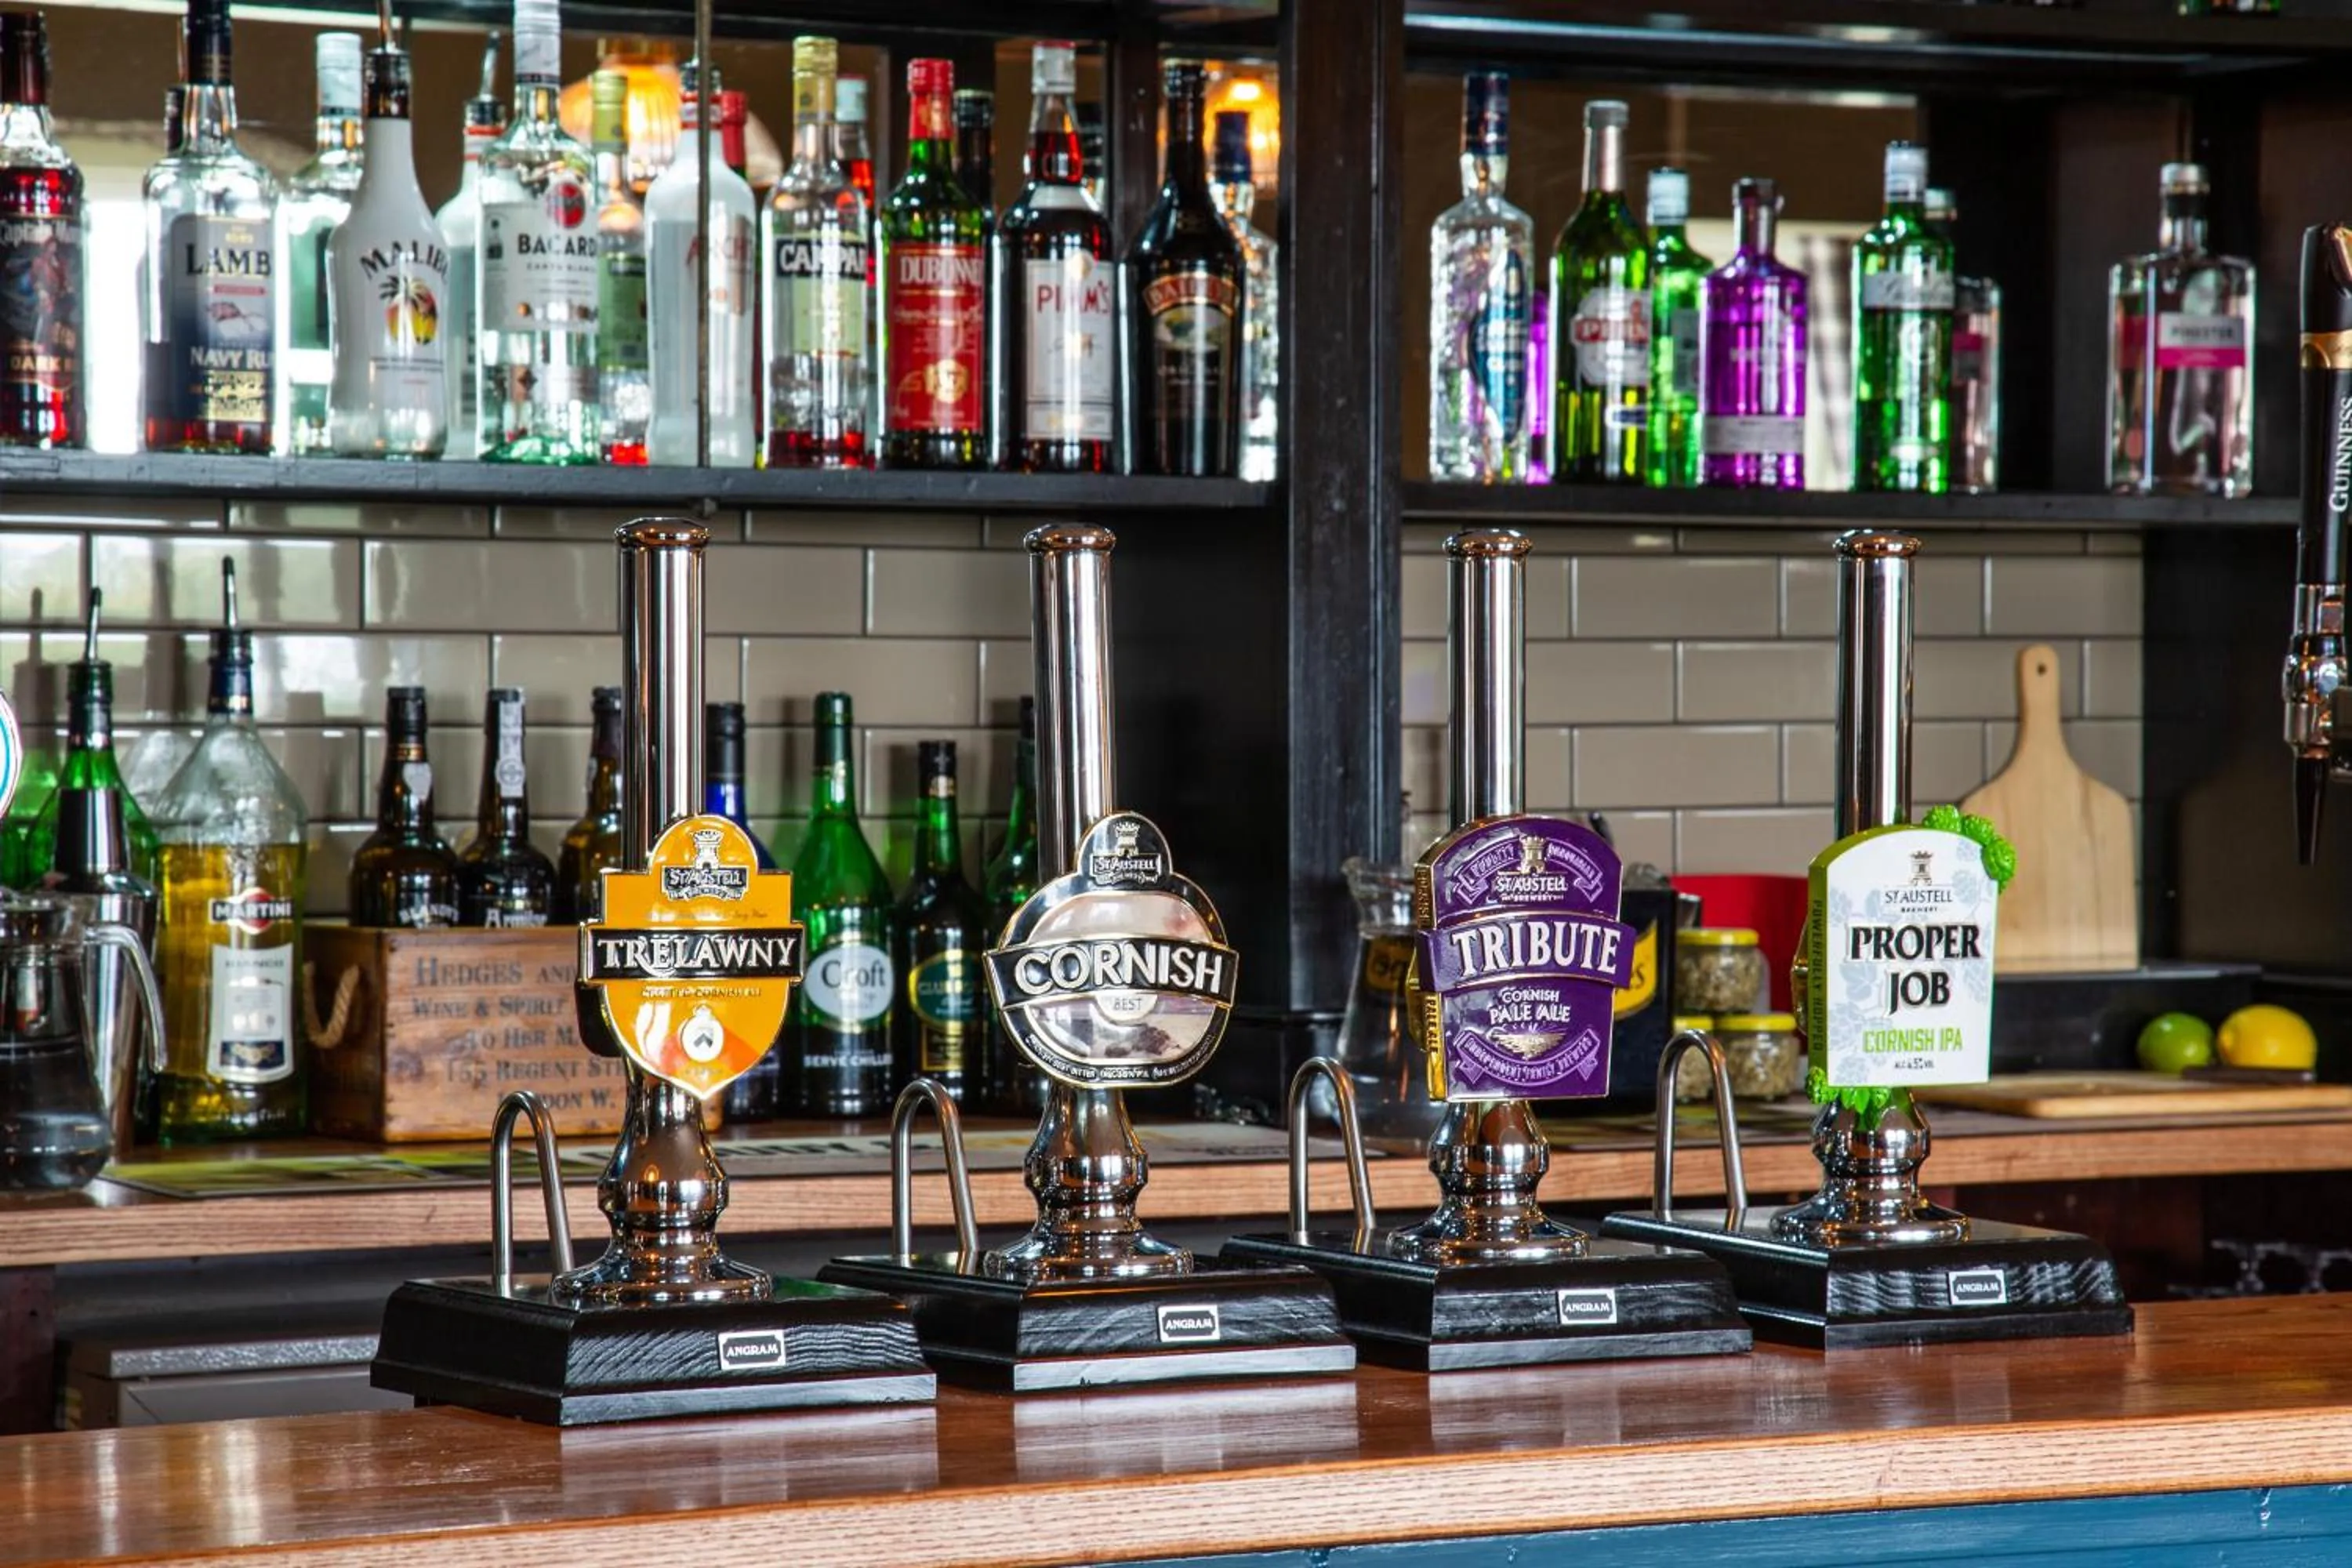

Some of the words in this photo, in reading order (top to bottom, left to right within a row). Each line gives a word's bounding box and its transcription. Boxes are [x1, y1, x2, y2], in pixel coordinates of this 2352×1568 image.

[361, 241, 448, 283] MALIB
[2328, 396, 2352, 513] GUINNESS
[215, 902, 292, 918] MARTINI
[1453, 920, 1621, 977] TRIBUTE
[1849, 924, 1981, 961] PROPER
[597, 934, 797, 978] TRELAWNY
[416, 957, 523, 987] HEDGES
[821, 959, 887, 989] Croft
[1014, 942, 1223, 996] CORNISH
[1112, 998, 1143, 1011] BEST
[1501, 989, 1560, 1004] CORNISH
[1888, 971, 1951, 1016] JOB
[412, 996, 468, 1018] WINE
[474, 996, 489, 1017] &
[1490, 1004, 1533, 1025] PALE
[1535, 1004, 1571, 1022] ALE
[504, 1028, 546, 1049] HER
[1863, 1028, 1935, 1053] CORNISH
[1940, 1027, 1963, 1051] IPA
[496, 1059, 580, 1082] REGENT
[1955, 1282, 2001, 1294] ANGRAM
[1565, 1301, 1610, 1314] ANGRAM
[1164, 1316, 1213, 1332] ANGRAM
[725, 1343, 779, 1359] ANGRAM
